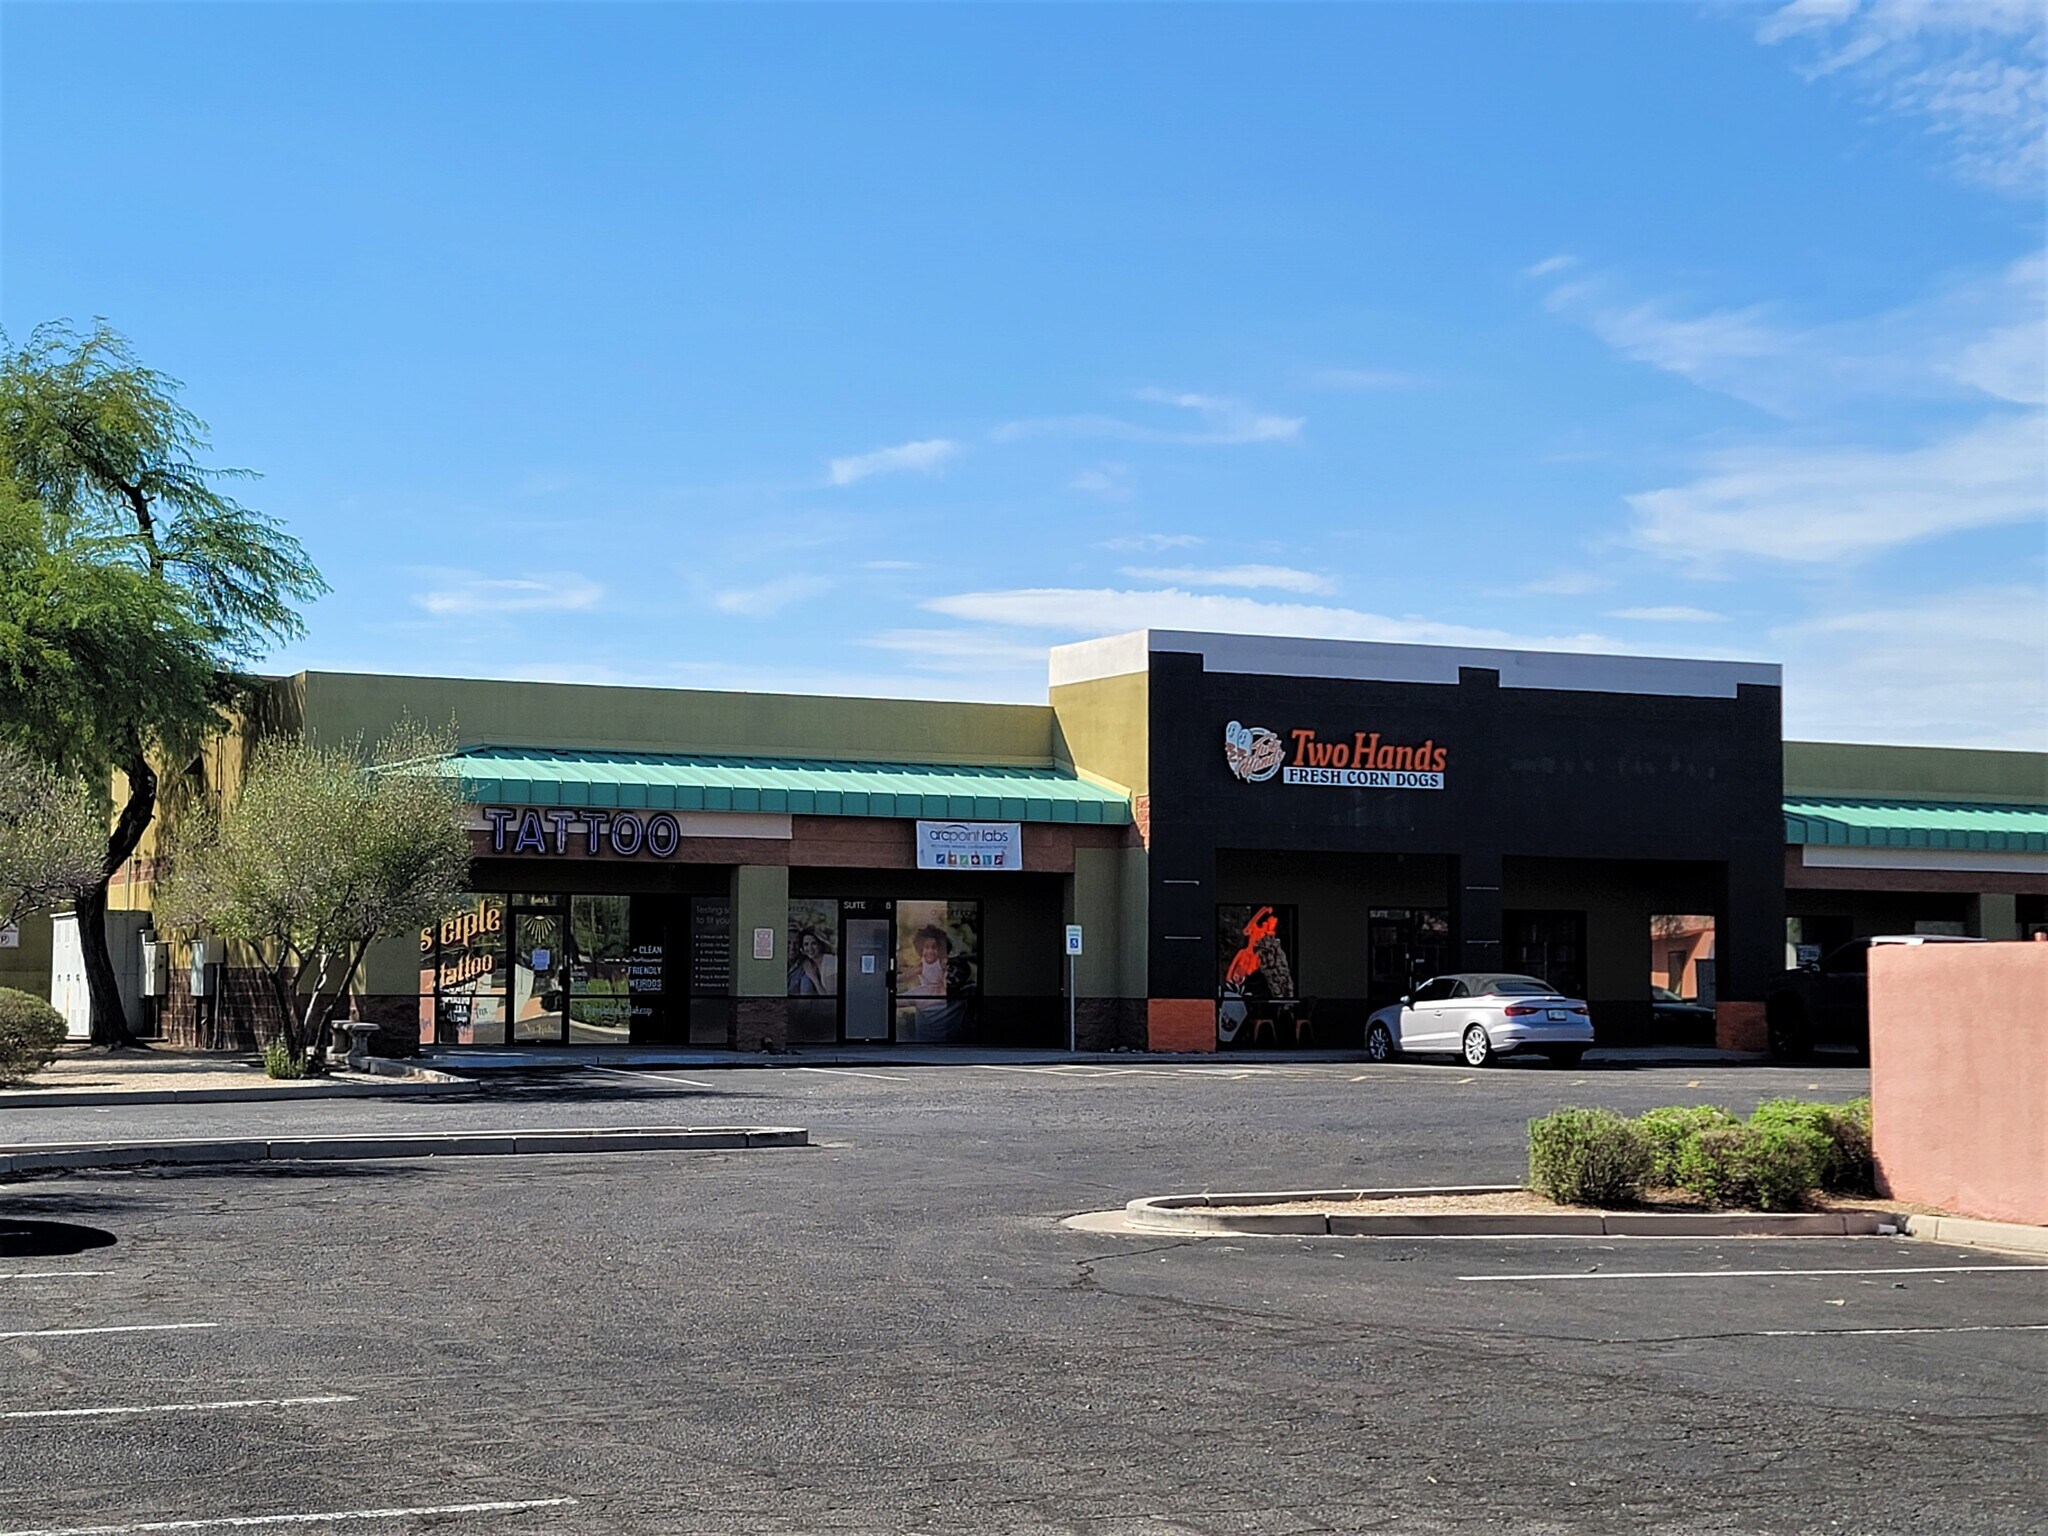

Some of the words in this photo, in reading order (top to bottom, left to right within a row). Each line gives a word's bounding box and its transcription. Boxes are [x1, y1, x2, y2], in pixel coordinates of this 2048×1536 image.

[1291, 729, 1349, 767] Two
[1351, 732, 1447, 771] Hands
[1289, 769, 1341, 784] FRESH
[1347, 771, 1390, 786] CORN
[1396, 773, 1439, 787] DOGS
[483, 807, 681, 858] TATTOO
[982, 829, 1008, 842] labs
[843, 901, 866, 909] SUITE
[696, 916, 705, 924] to
[639, 945, 662, 954] CLEAN
[440, 952, 493, 987] tattoo
[628, 966, 662, 975] FRIENDLY
